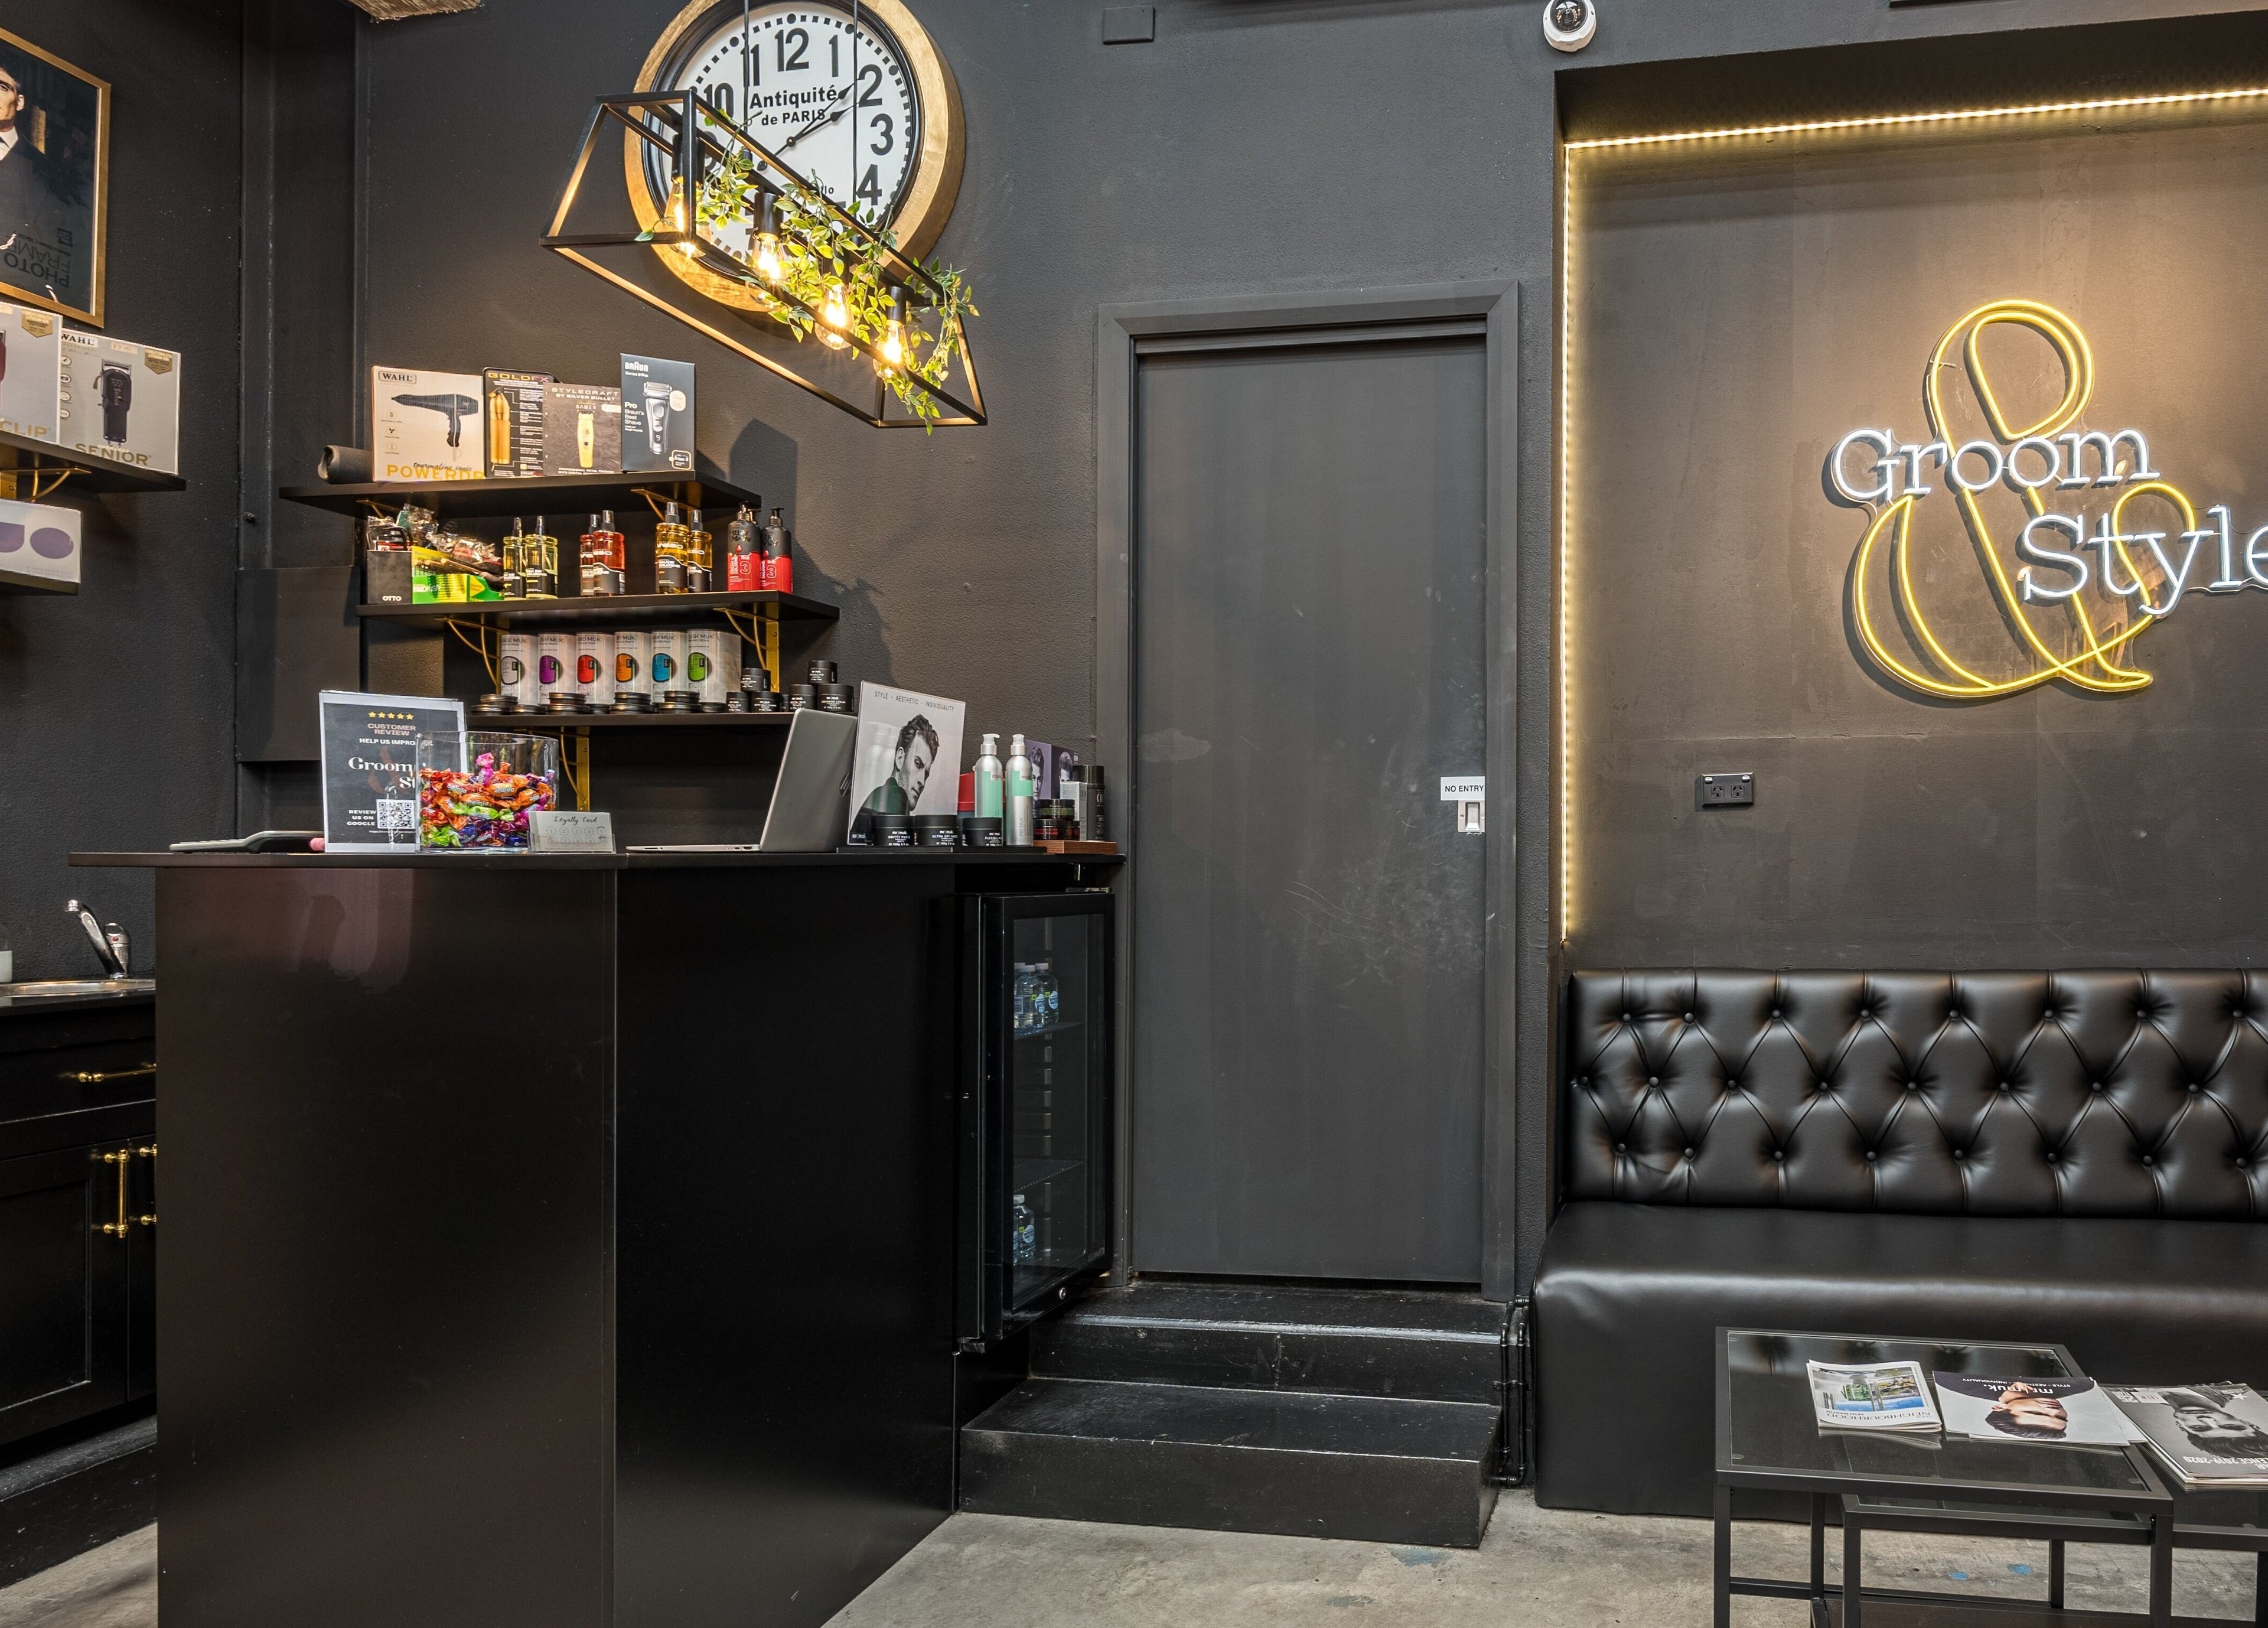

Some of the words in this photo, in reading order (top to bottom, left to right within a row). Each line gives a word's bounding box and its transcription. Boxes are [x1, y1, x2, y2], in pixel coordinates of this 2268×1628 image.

[775, 27, 809, 72] 12
[828, 34, 839, 78] 1
[858, 63, 883, 108] 2
[703, 82, 734, 119] 10
[750, 85, 838, 110] Antiquité
[761, 113, 778, 126] de
[782, 108, 826, 124] PARIS
[870, 113, 894, 156] 3
[856, 164, 882, 206] 4
[4, 252, 70, 288] PHOTO
[61, 333, 95, 346] WAHL
[382, 373, 413, 382] WAHL
[488, 372, 549, 382] GOLDFX
[551, 387, 618, 396] STYLECRAFT
[1, 421, 47, 437] CLIP
[413, 462, 453, 471] tourmaline
[1833, 426, 2161, 502] Groom
[739, 561, 751, 575] 3
[766, 564, 777, 579] 3
[874, 691, 888, 699] STYLE
[895, 695, 919, 705] AESTHETIC
[925, 701, 954, 712] INDIVIDUALITY
[348, 757, 413, 772] Groom
[1827, 1411, 1931, 1421] NEIGHBOURHOOD
[2182, 1456, 2237, 1464] 2019-2020
